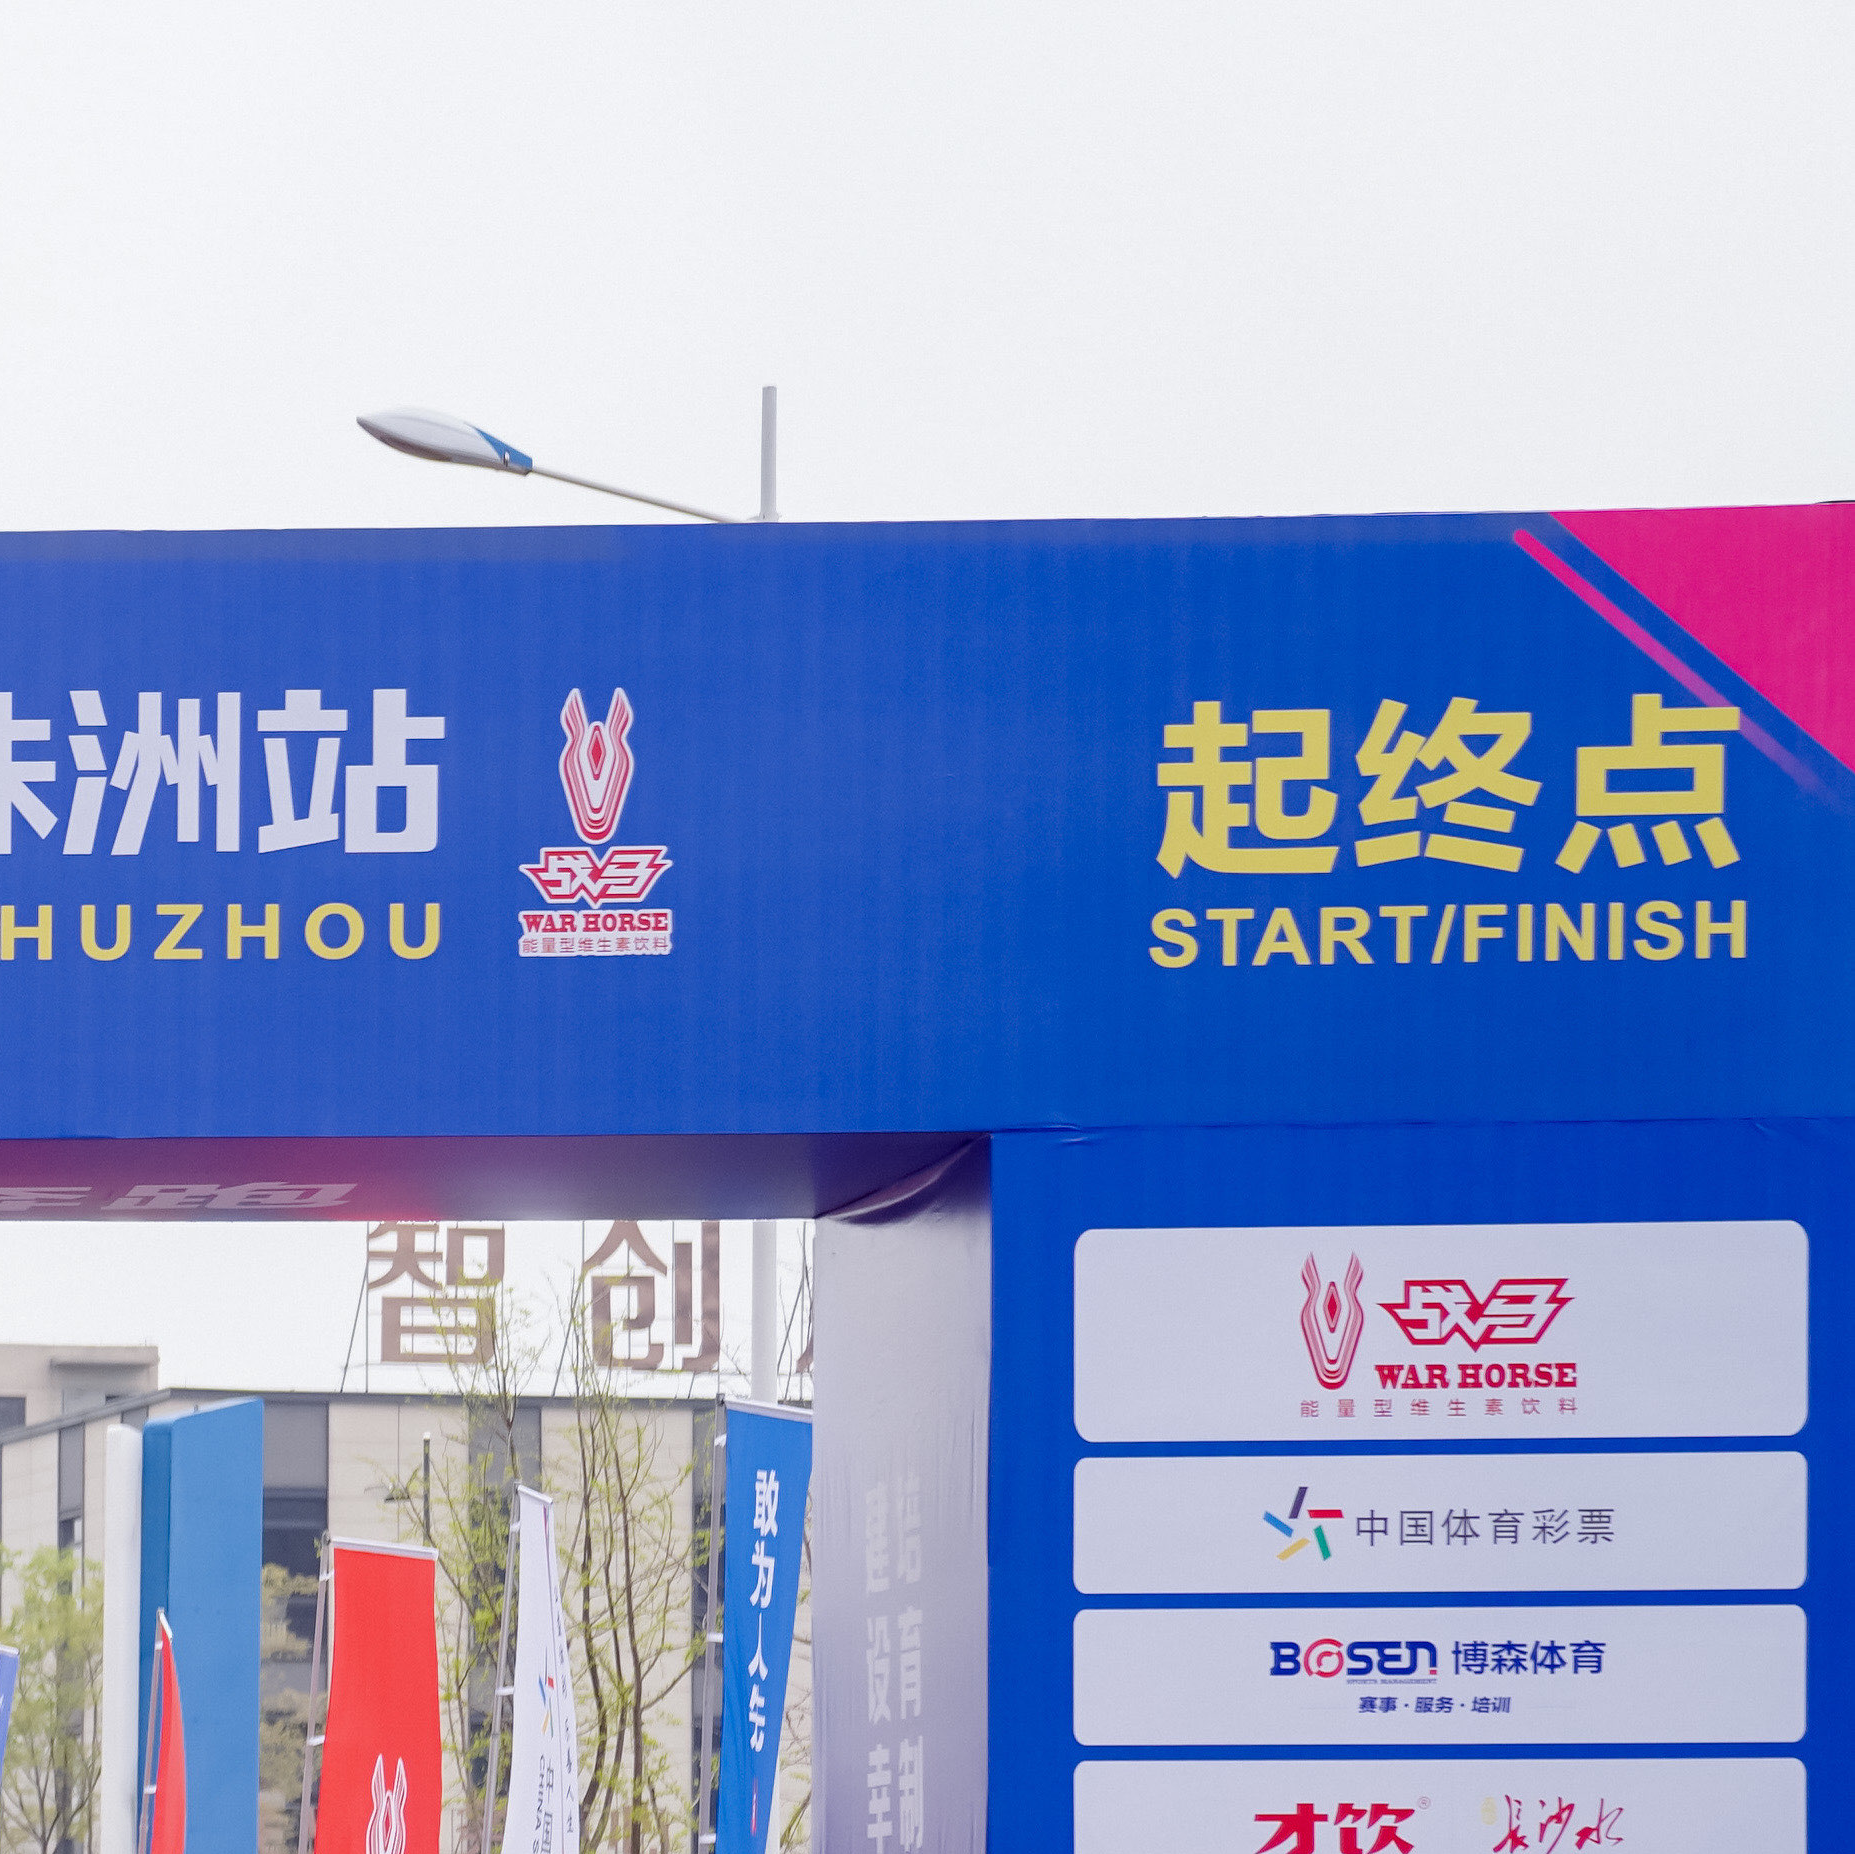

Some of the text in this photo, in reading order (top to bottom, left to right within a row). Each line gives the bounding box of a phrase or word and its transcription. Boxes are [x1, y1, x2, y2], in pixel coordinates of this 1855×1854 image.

[1155, 693, 1742, 880] 起终点
[523, 913, 669, 933] WAR HORSE
[1150, 900, 1749, 969] START/FINISH
[1375, 1362, 1578, 1390] WAR HORSE
[1300, 1397, 1579, 1418] 能量型维生素饮料
[1355, 1508, 1616, 1547] 中国体育彩票
[747, 1468, 781, 1755] 敢为人先
[1270, 1638, 1437, 1678] BOSEN
[1452, 1640, 1607, 1675] 博森体育
